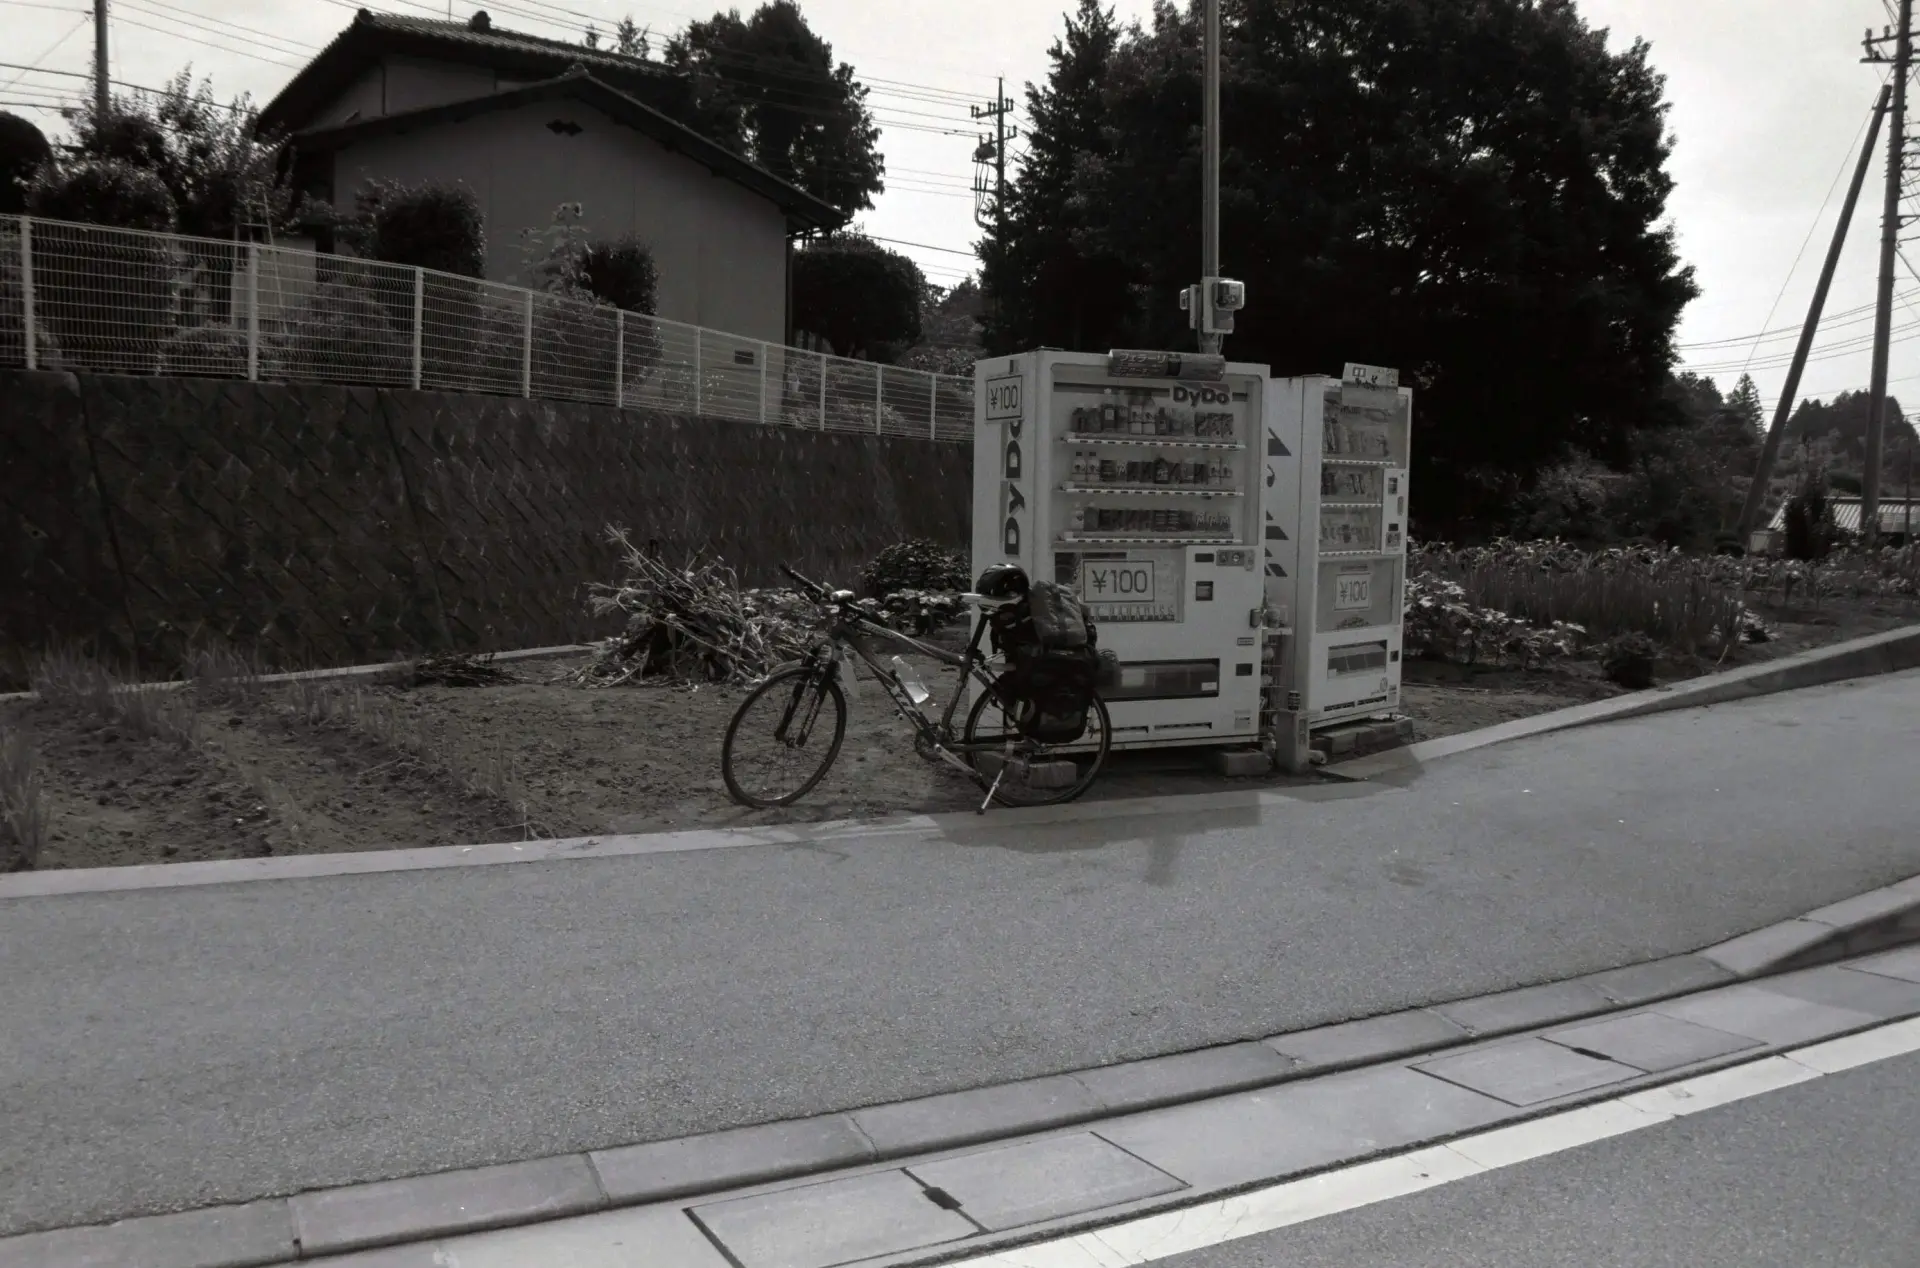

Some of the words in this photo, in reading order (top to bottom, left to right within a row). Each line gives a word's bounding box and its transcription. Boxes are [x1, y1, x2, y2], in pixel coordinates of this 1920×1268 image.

[990, 384, 1018, 411] ¥100
[1173, 386, 1230, 408] DyDo
[1091, 568, 1148, 595] ¥100
[1339, 580, 1368, 603] ¥100
